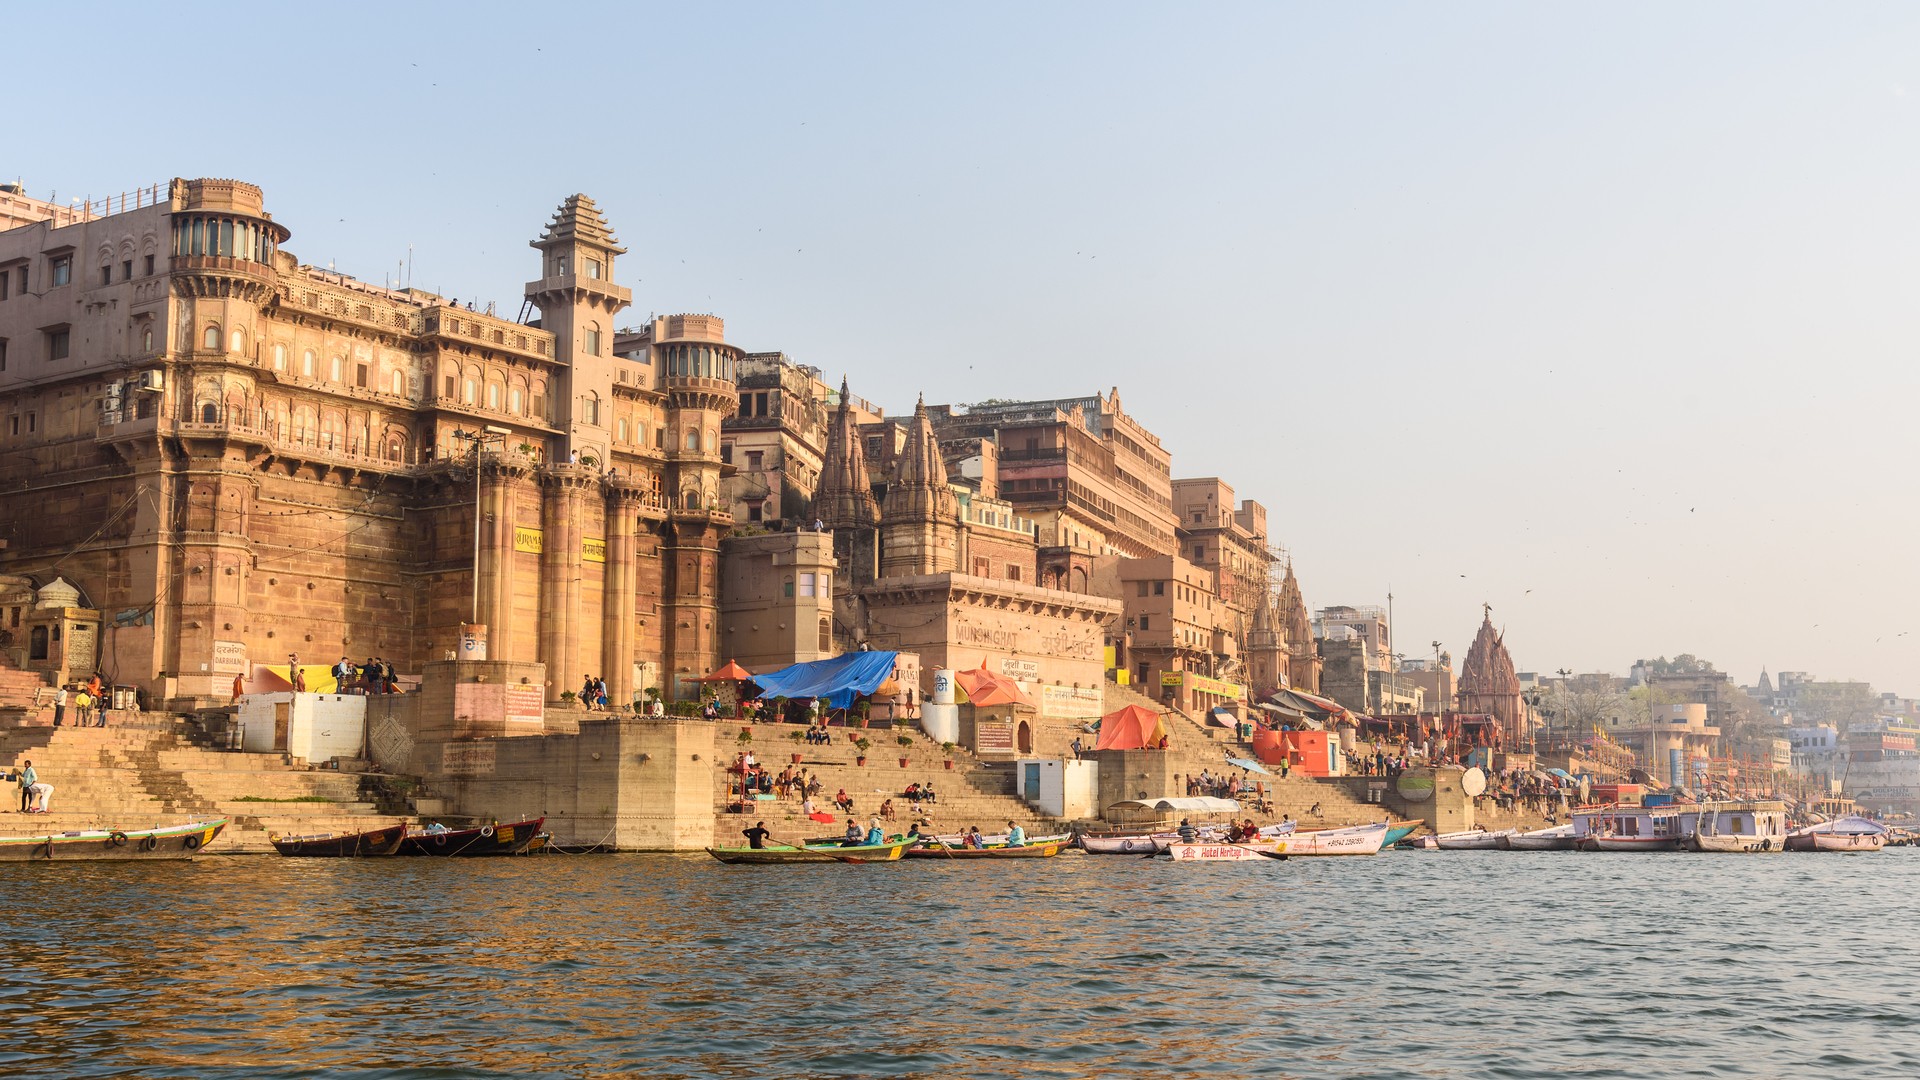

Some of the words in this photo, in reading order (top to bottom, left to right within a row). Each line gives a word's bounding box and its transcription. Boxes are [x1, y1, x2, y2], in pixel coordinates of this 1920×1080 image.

[955, 625, 1018, 648] MUNSHIGHAT
[1201, 847, 1219, 858] Hotel
[1220, 847, 1242, 860] Heritage
